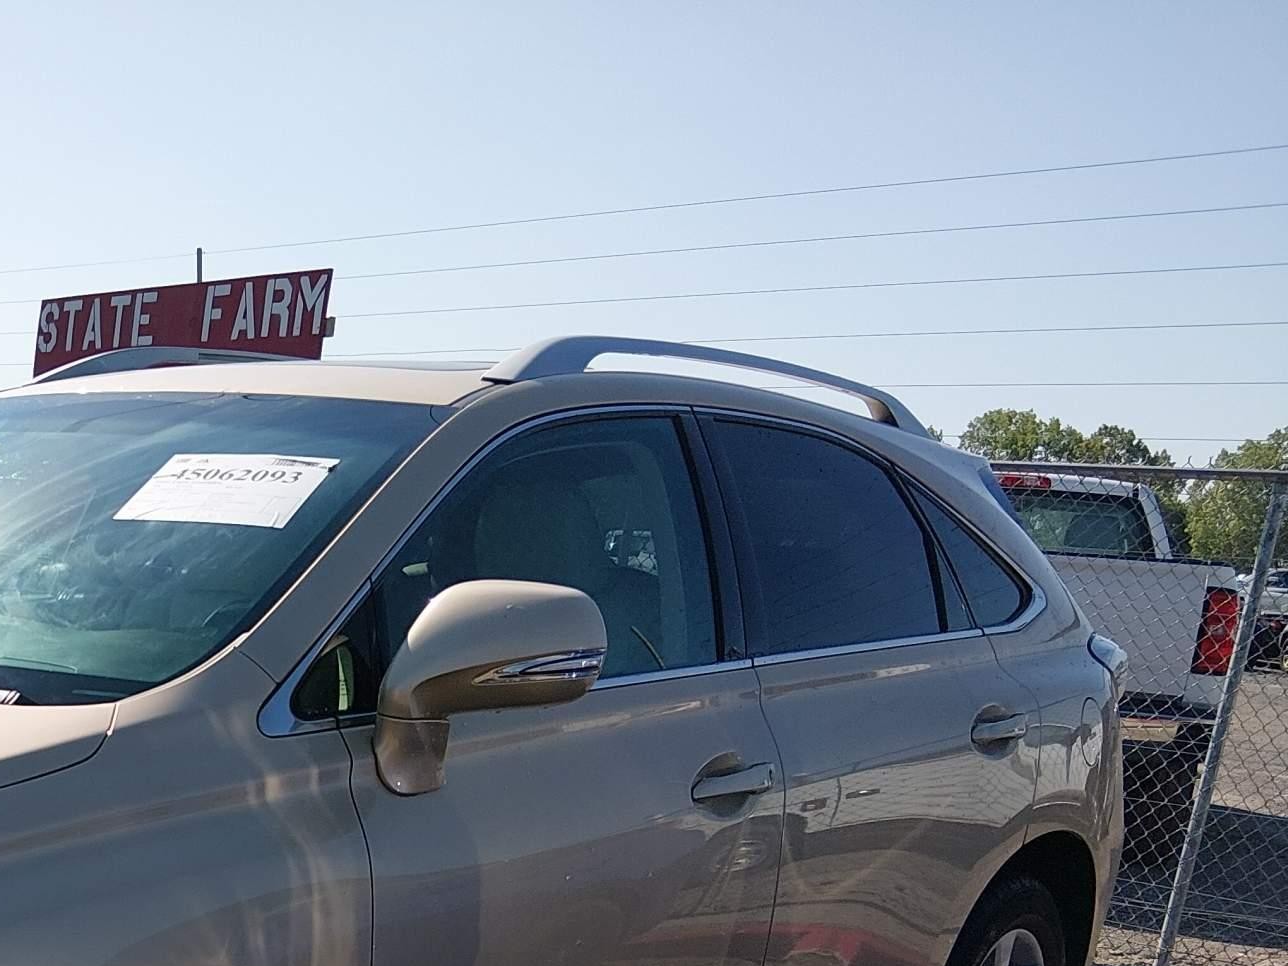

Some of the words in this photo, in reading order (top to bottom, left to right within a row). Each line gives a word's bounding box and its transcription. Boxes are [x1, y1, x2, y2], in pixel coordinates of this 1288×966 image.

[37, 291, 158, 352] STATE
[201, 273, 329, 342] FARM
[172, 467, 304, 484] 45062093
